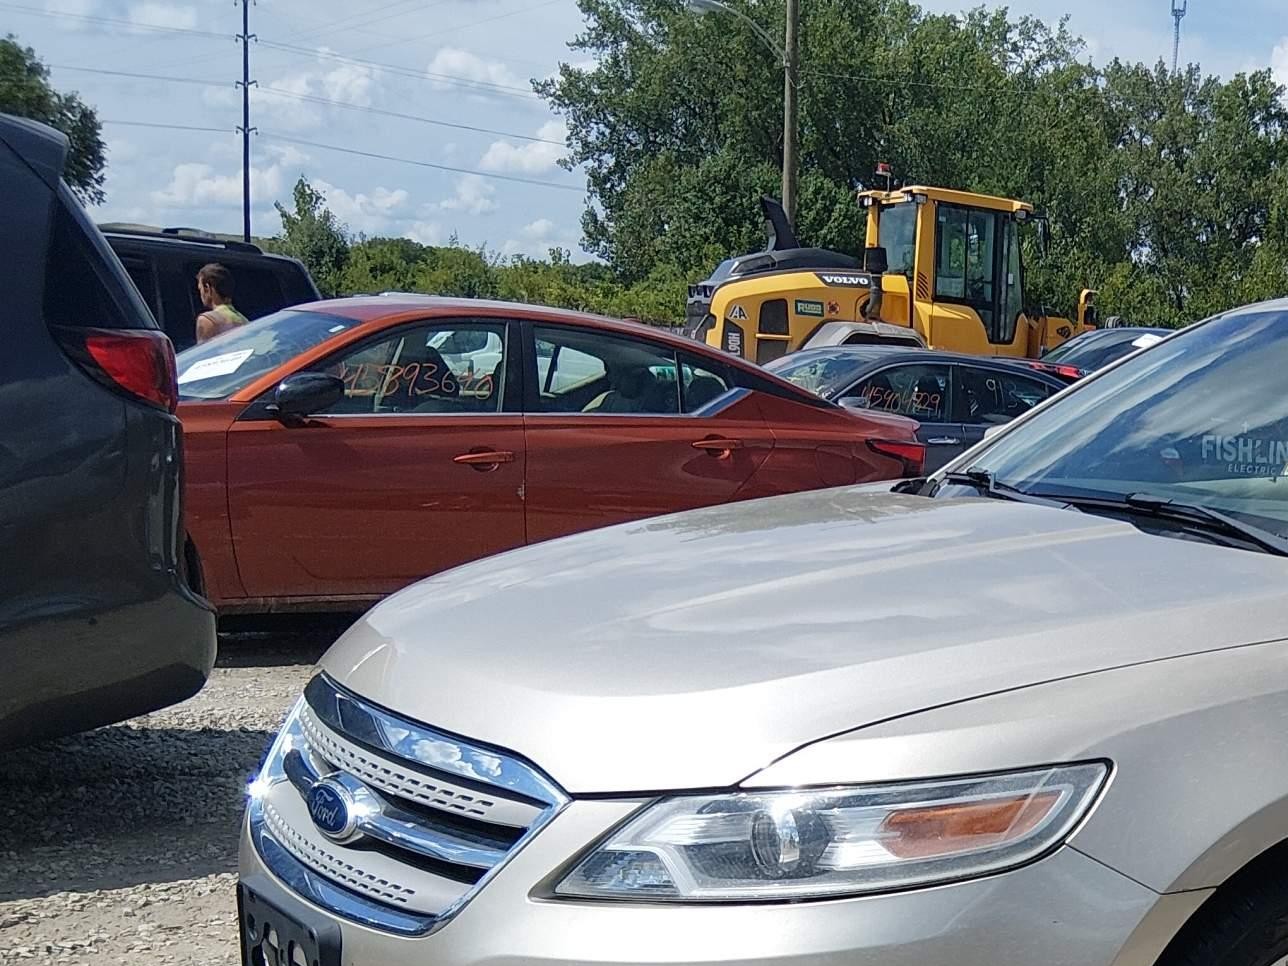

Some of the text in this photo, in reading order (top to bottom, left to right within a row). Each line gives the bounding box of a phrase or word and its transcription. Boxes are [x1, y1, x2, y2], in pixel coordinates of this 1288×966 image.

[822, 275, 869, 285] VOLVO
[1227, 464, 1277, 475] ELECTRIC
[311, 789, 339, 827] Ford
